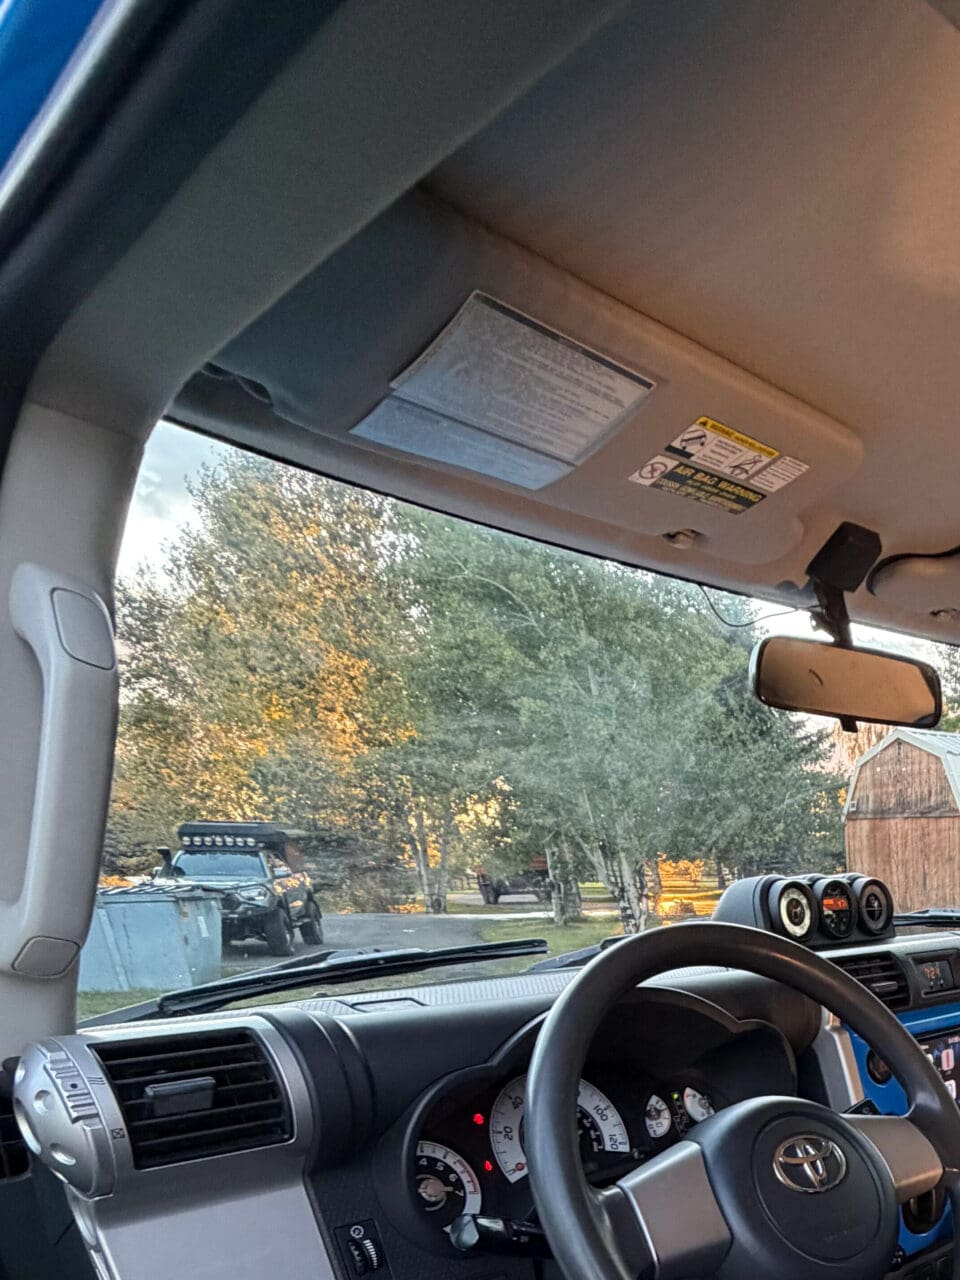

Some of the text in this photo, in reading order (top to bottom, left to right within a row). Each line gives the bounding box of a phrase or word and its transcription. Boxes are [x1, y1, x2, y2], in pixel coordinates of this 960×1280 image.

[511, 1095, 524, 1110] 40
[593, 1104, 609, 1122] 100
[503, 1126, 514, 1141] 20
[608, 1133, 619, 1151] 120
[419, 1157, 428, 1166] 4
[435, 1161, 446, 1171] 5
[448, 1173, 459, 1183] 6
[455, 1189, 465, 1197] 7
